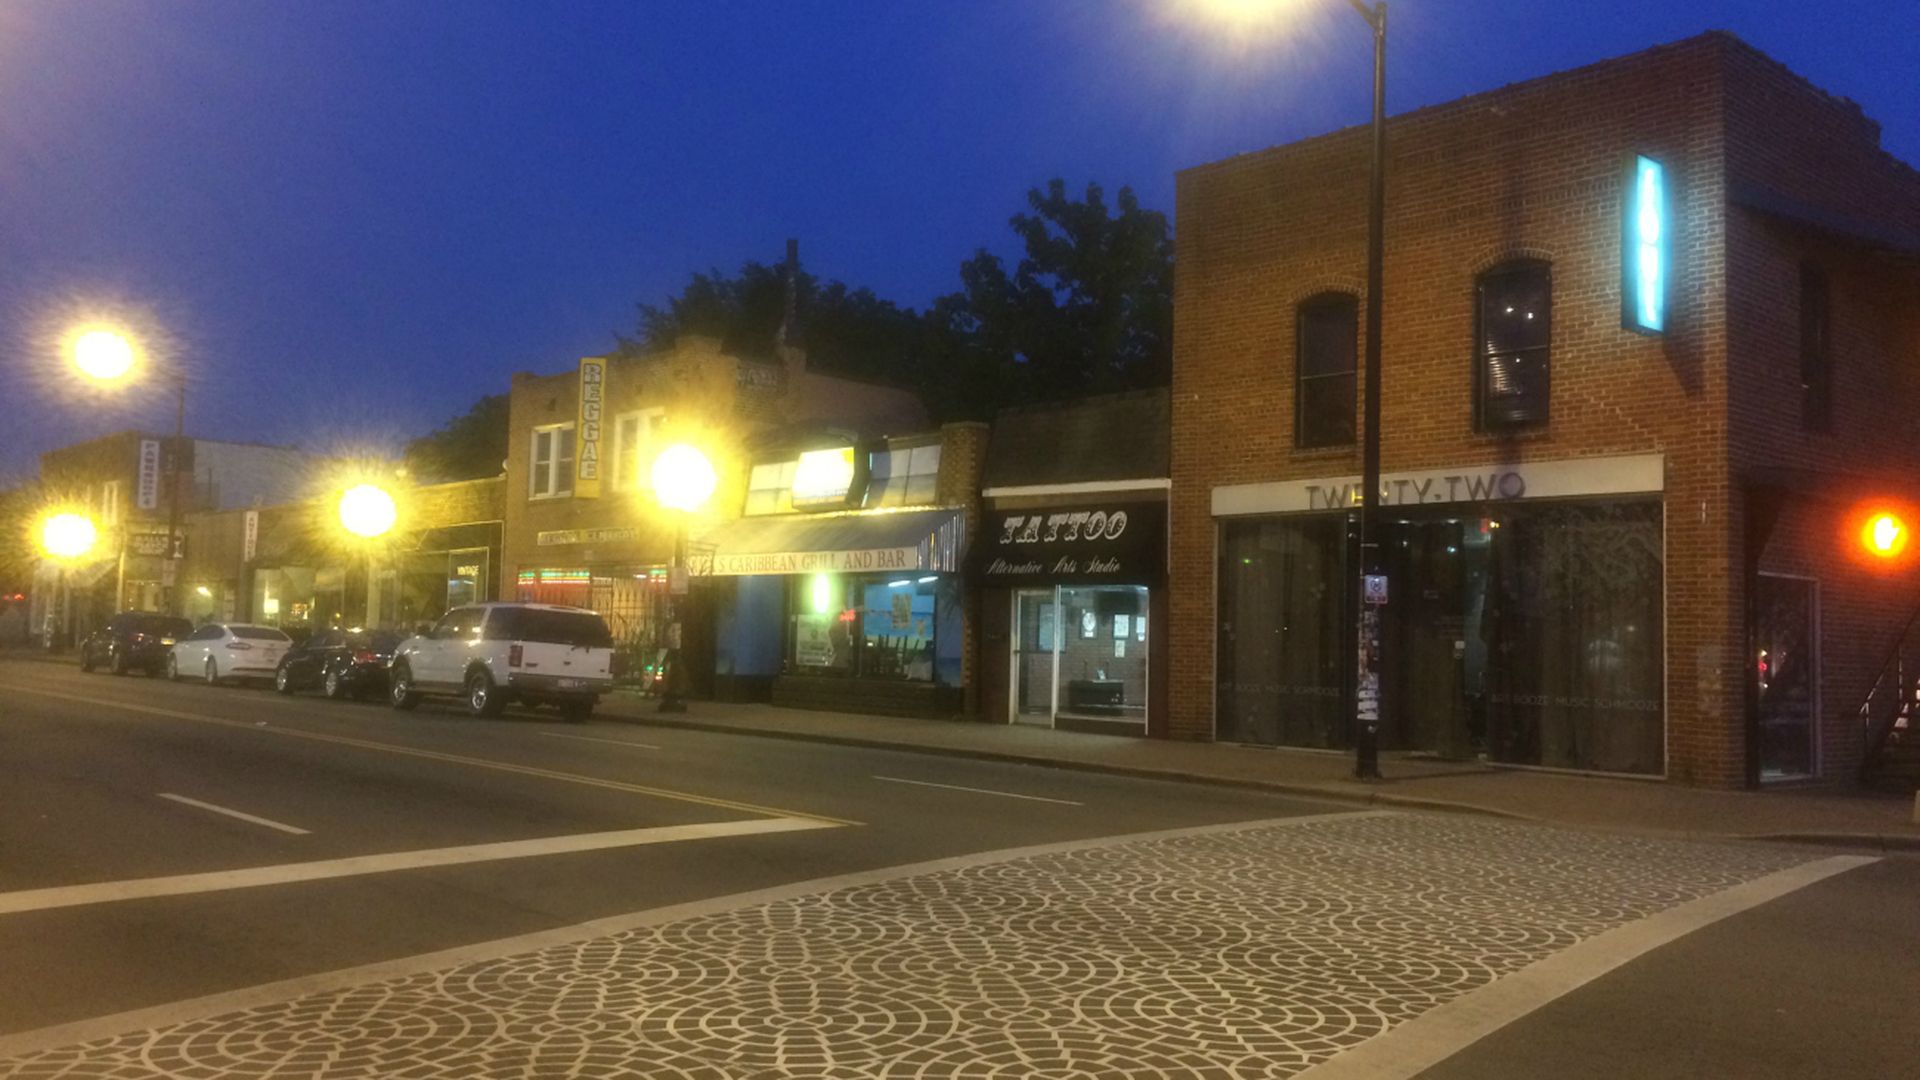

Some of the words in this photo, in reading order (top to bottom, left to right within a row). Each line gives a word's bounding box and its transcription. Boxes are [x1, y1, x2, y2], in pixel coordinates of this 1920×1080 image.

[580, 363, 601, 480] REGGAE
[1000, 510, 1127, 544] TATTOO
[729, 555, 796, 572] CARIBBEAN
[802, 553, 839, 570] GRILL
[844, 551, 873, 569] AND
[878, 548, 906, 568] BAR
[987, 558, 1042, 574] Alternative
[1050, 555, 1077, 574] Arts
[1083, 555, 1120, 574] Studio
